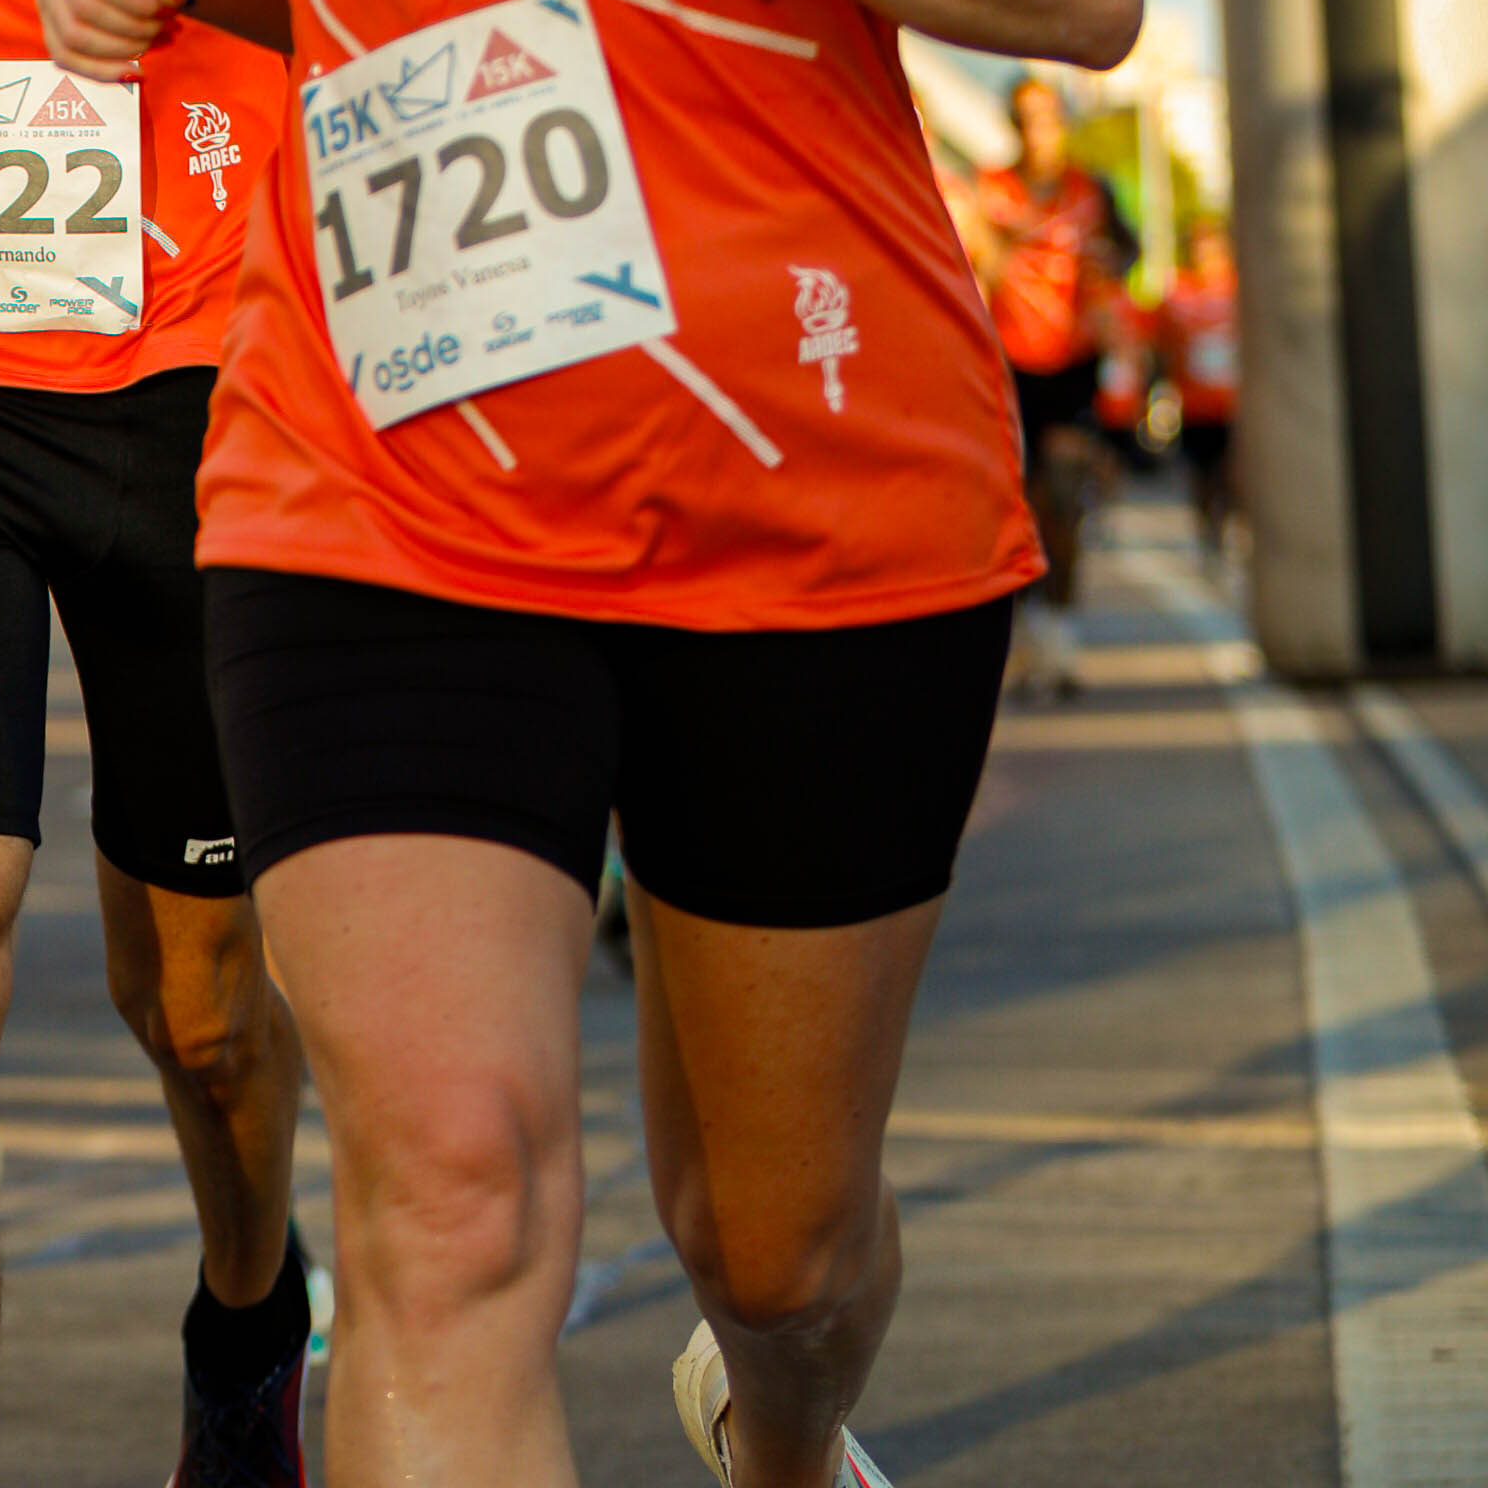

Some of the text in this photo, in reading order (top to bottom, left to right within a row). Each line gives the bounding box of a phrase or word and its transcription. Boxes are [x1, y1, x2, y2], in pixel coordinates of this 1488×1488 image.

[45, 99, 88, 121] 15K
[309, 88, 380, 159] 15K
[32, 129, 44, 138] DE
[47, 129, 75, 138] ABRIL
[188, 143, 242, 177] ARDEC
[313, 107, 611, 303] 1720
[49, 298, 95, 308] POWER
[374, 330, 461, 391] osde
